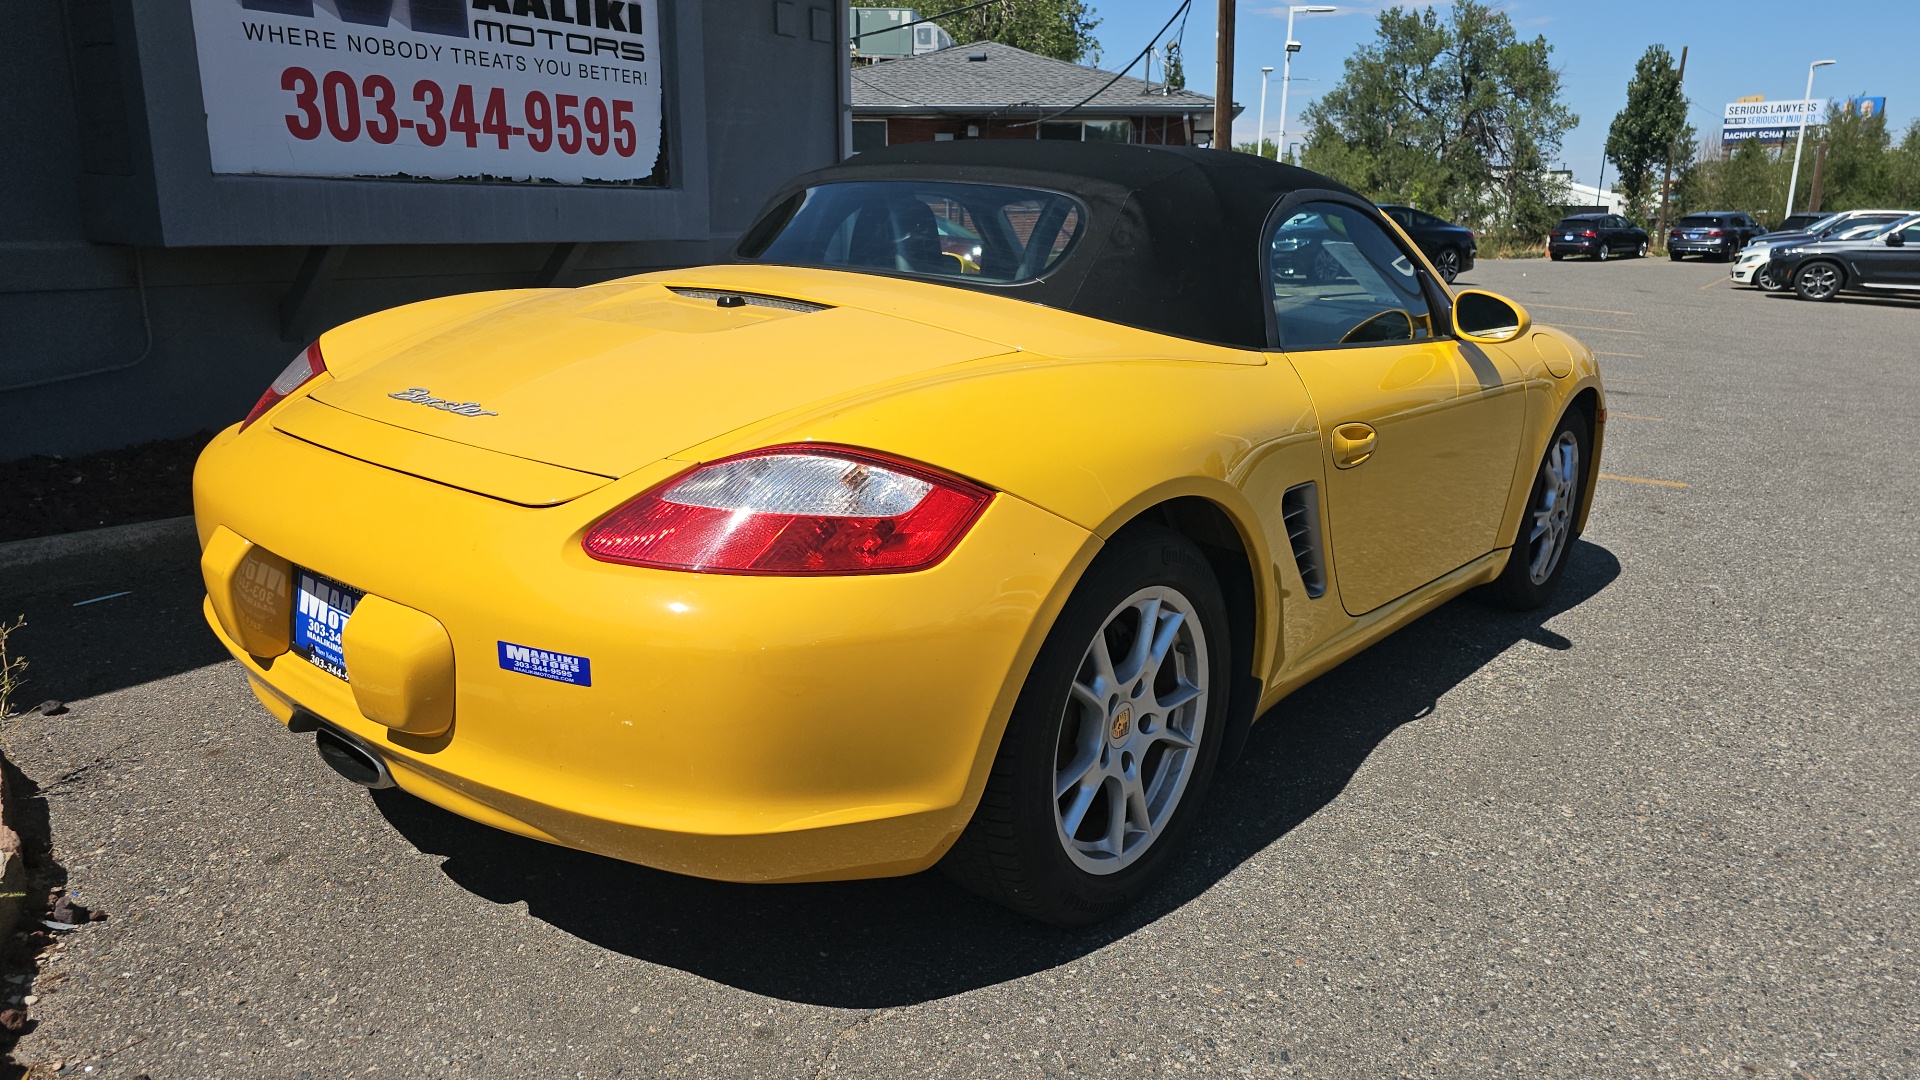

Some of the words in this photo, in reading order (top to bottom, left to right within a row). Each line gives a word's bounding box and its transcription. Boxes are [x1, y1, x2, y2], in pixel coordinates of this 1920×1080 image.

[474, 20, 645, 62] MOTORS
[242, 22, 337, 50] WHERE
[347, 35, 442, 61] NOBODY
[450, 47, 527, 72] TREATS
[534, 58, 571, 77] YOU
[579, 64, 648, 85] BETTER!
[280, 66, 638, 158] 303-344-9595
[1728, 105, 1769, 116] SERIOUS
[1747, 115, 1785, 125] SERIOUSLY
[1786, 114, 1816, 124] INJUED
[506, 644, 579, 665] MAALIKI
[513, 666, 575, 683] MAALIKIMOTORS.COM
[514, 660, 573, 678] 303-344-9595
